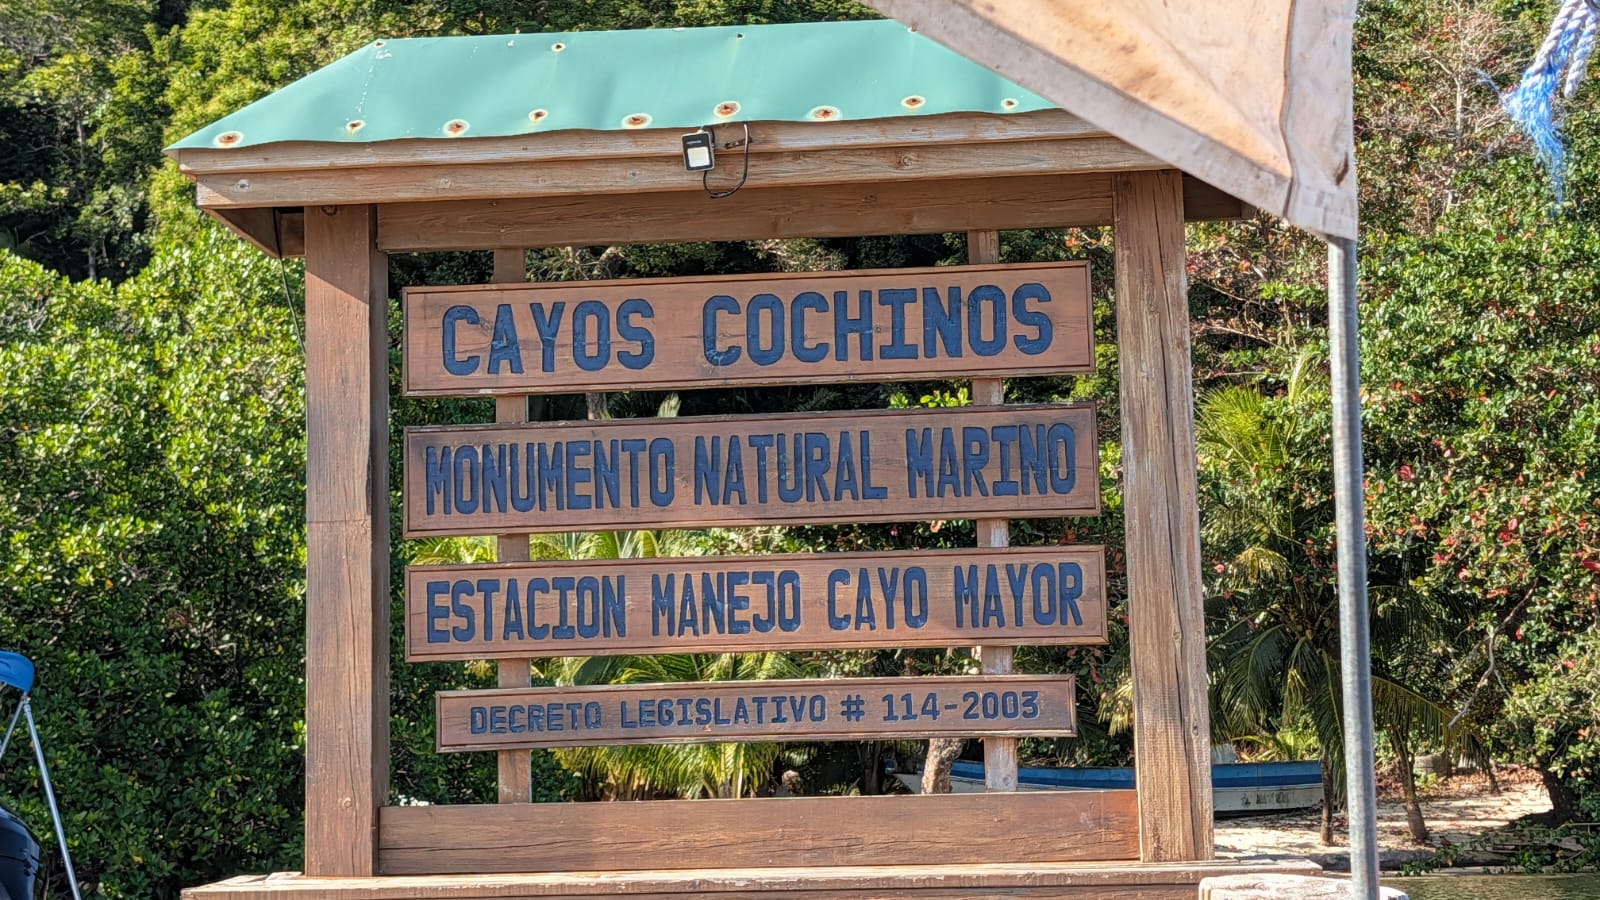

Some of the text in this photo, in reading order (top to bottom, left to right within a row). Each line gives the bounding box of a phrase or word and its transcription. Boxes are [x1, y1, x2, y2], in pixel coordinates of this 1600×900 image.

[442, 283, 1053, 375] CAYOS COCHINOS
[426, 423, 1076, 515] MONUMENTO NATURAL MARINO
[427, 562, 1083, 643] ESTACION MANEJO CAYO MAYOR
[470, 691, 1039, 734] DECRETO LEGISLATIVO # 114-2003
